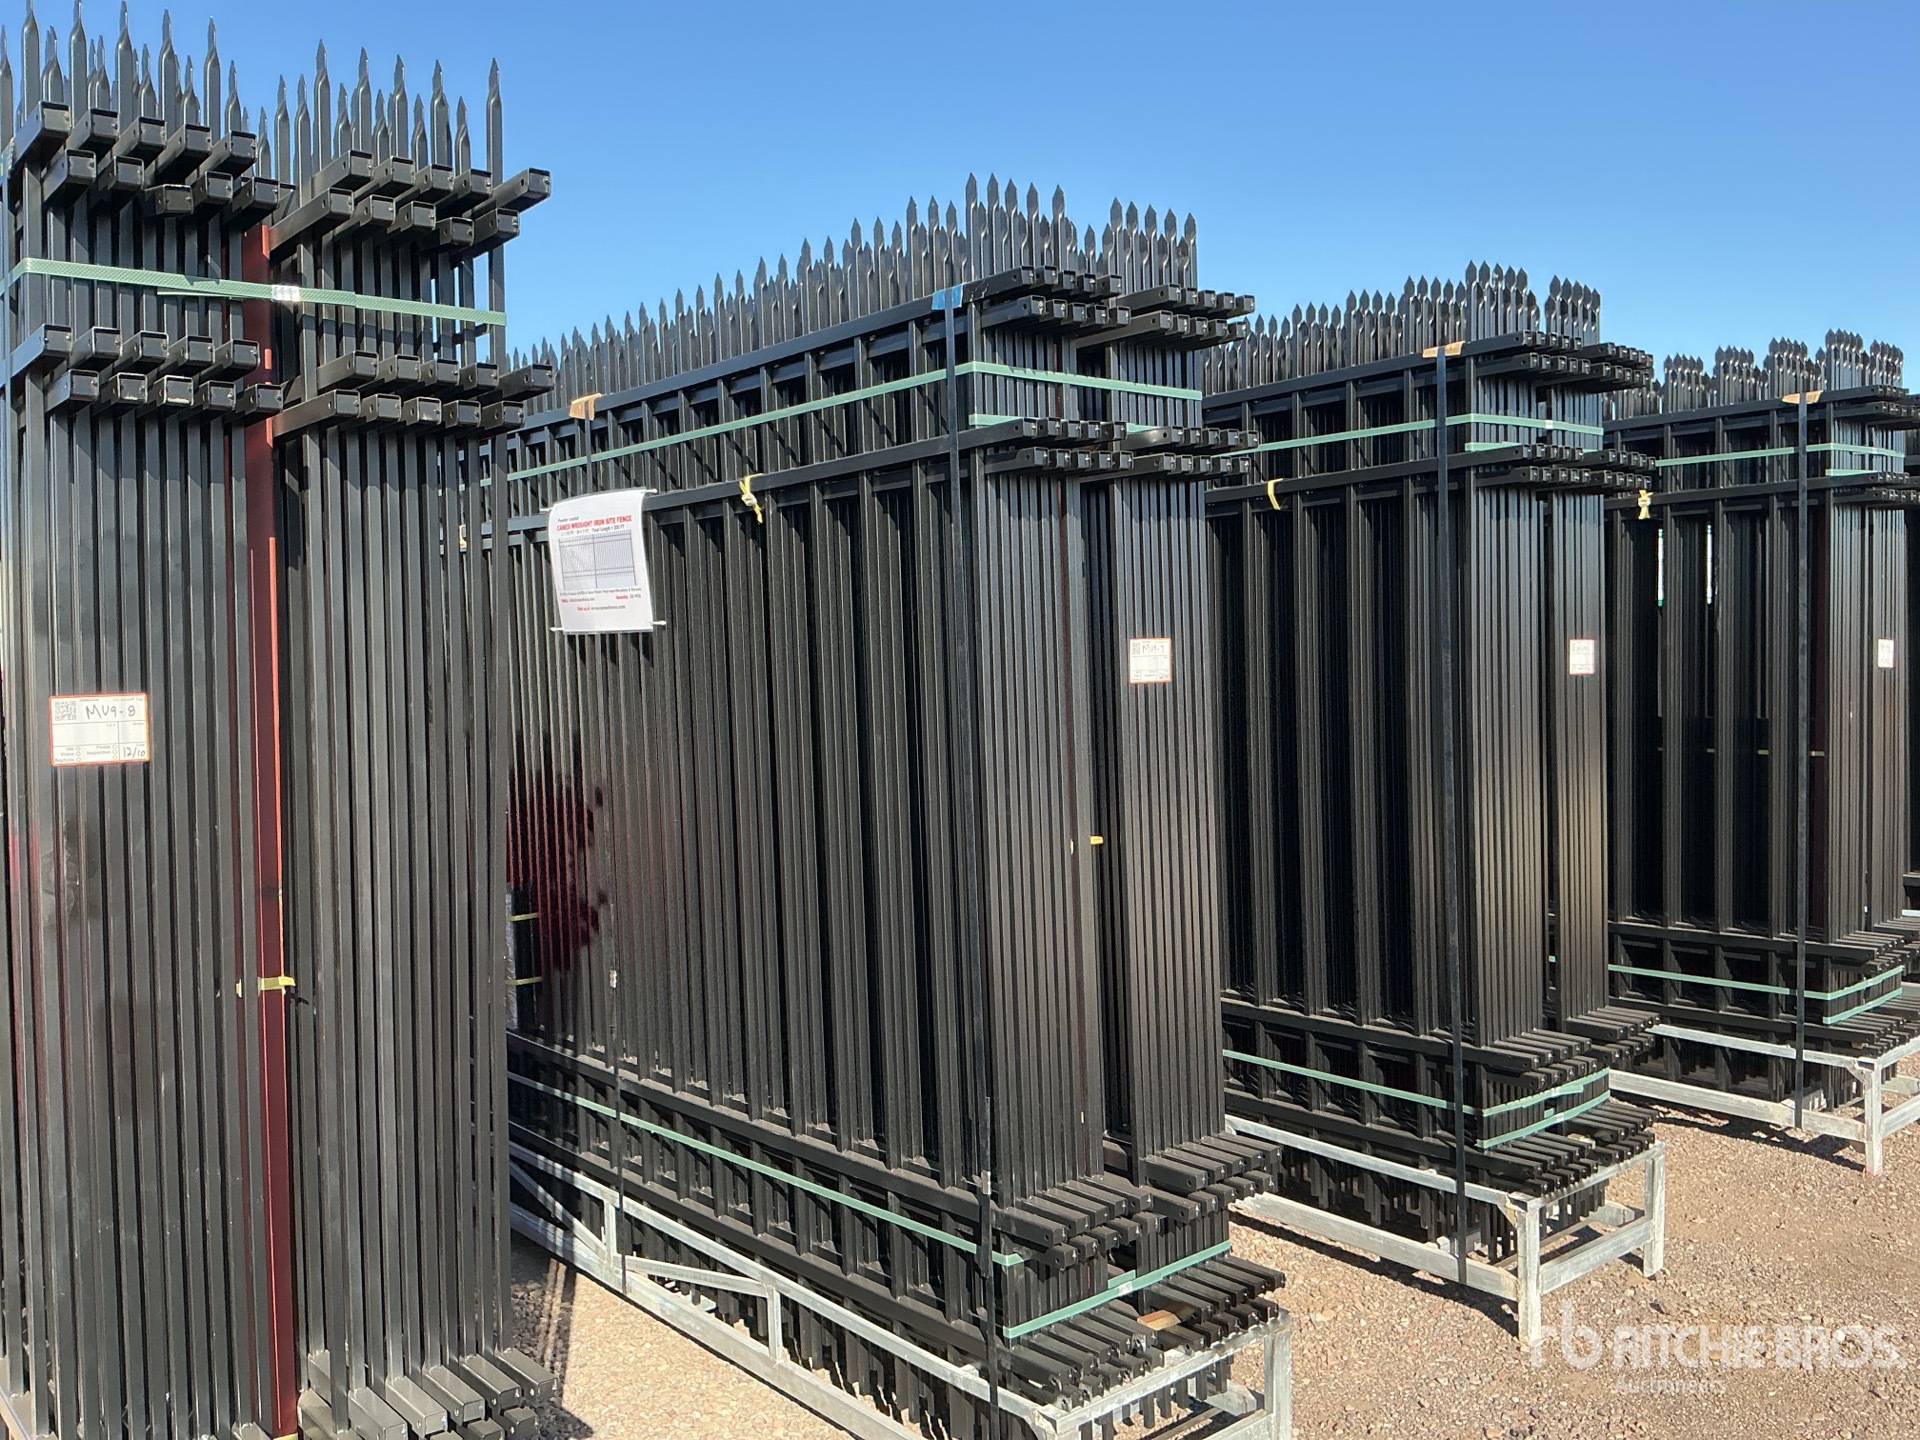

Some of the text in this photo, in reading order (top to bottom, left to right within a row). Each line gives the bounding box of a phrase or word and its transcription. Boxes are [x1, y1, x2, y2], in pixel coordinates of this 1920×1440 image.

[571, 521, 593, 529] WROUGHT
[617, 515, 632, 523] FENCE
[123, 747, 146, 758] 12/10
